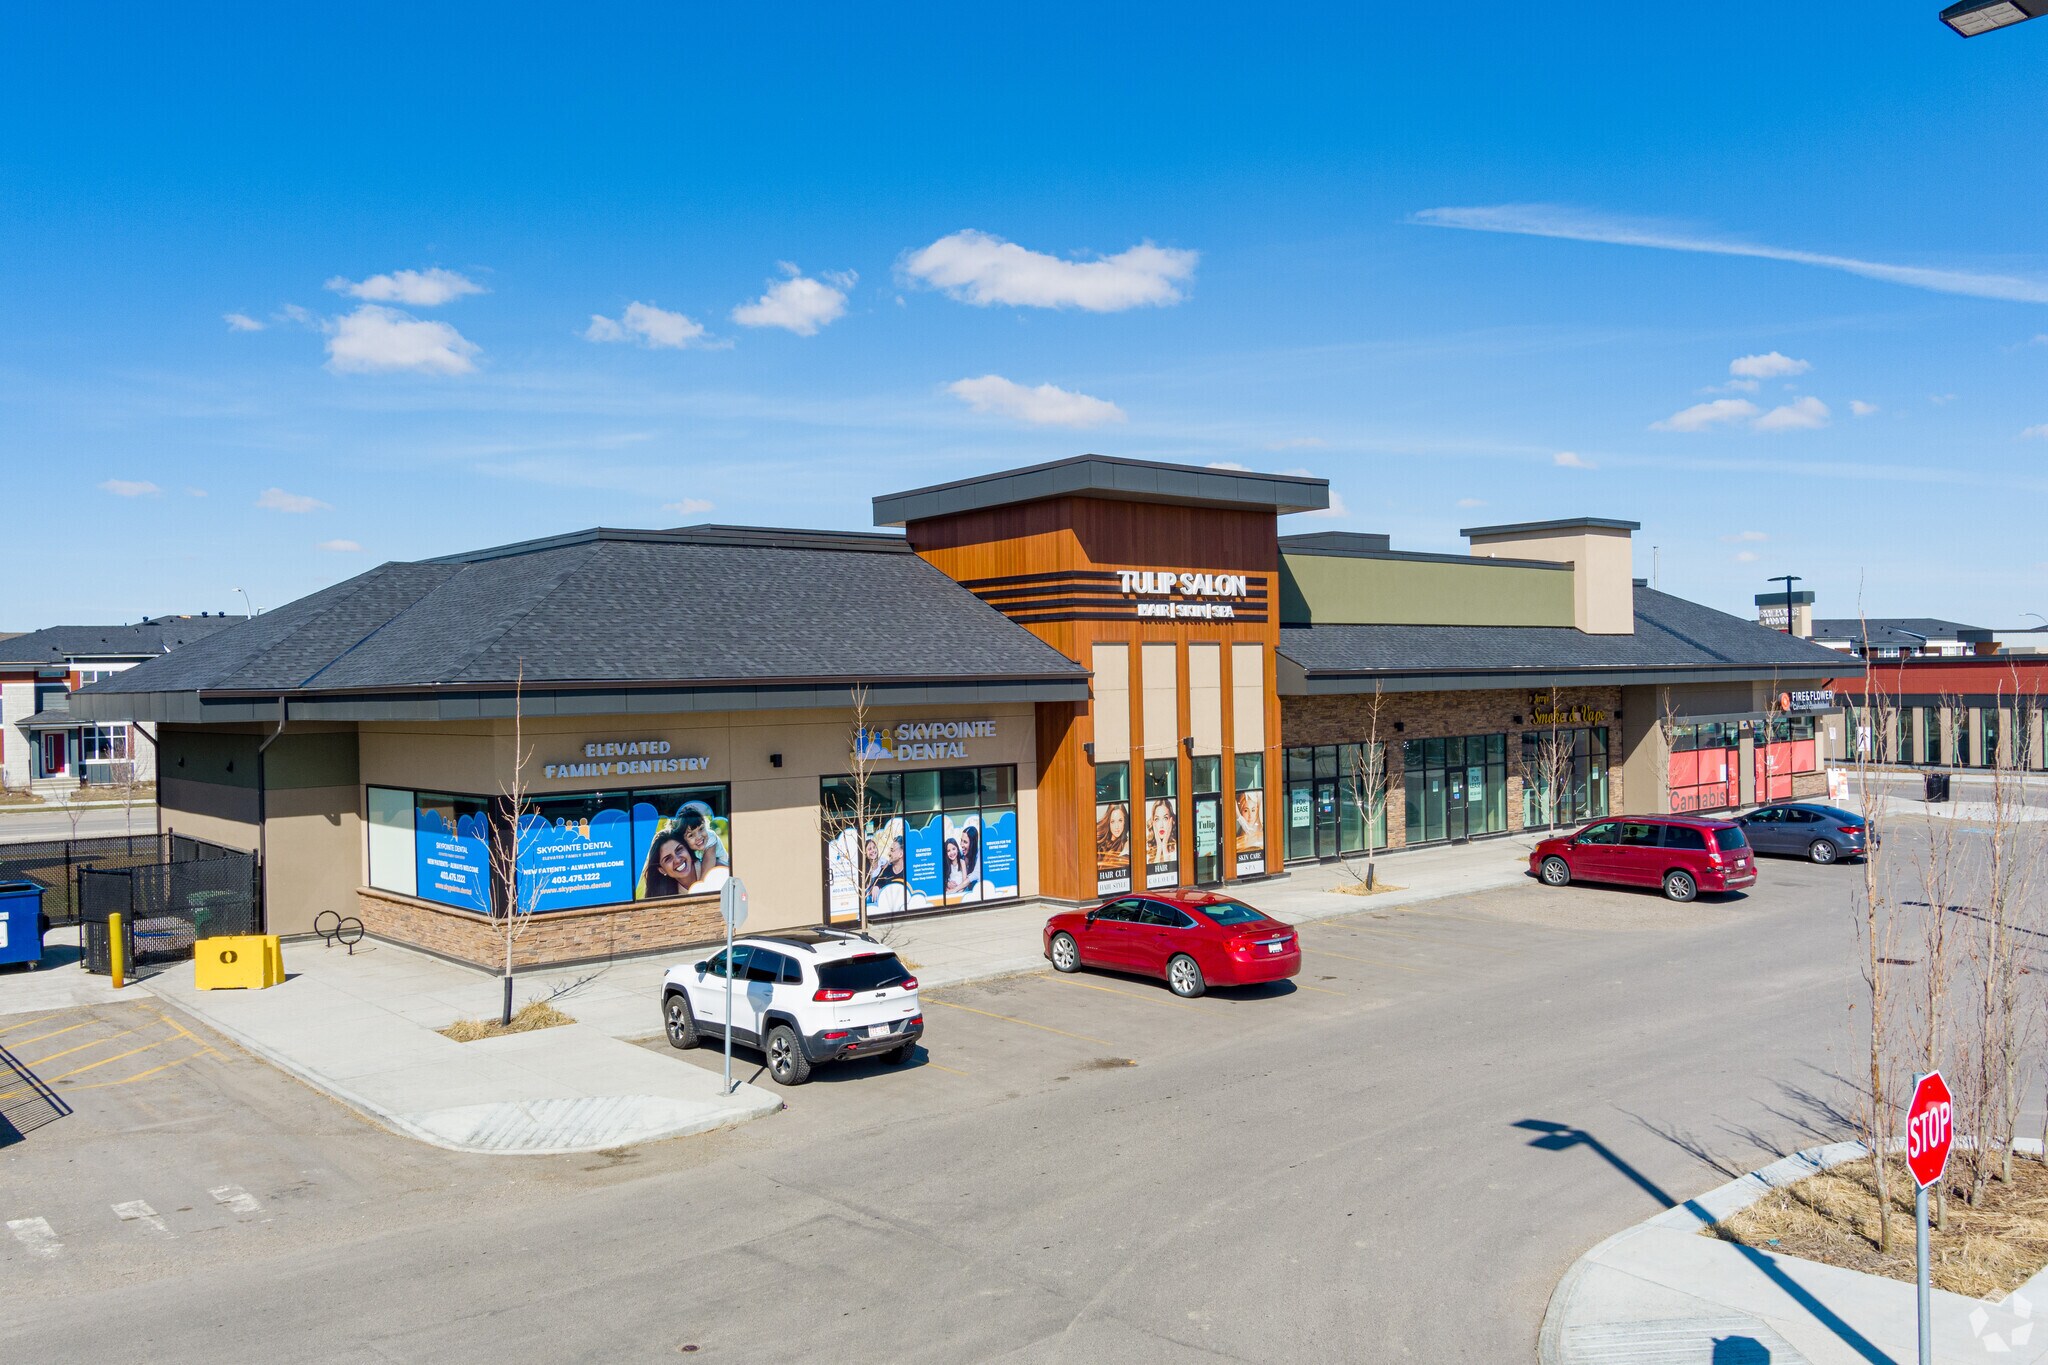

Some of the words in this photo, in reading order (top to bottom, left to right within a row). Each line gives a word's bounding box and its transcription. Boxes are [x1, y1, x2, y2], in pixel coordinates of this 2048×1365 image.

[1117, 570, 1177, 594] TULIP
[1180, 572, 1246, 597] SALON
[1137, 603, 1171, 617] HAIR
[1176, 604, 1207, 618] SKIN
[1211, 605, 1235, 618] SPA
[1532, 707, 1565, 725] Smoke
[1581, 704, 1606, 727] Vape
[897, 720, 997, 741] SKYPOINTE
[585, 741, 671, 758] ELEVATED
[897, 741, 969, 762] DENTAL
[545, 762, 612, 779] FAMILY
[616, 757, 710, 775] DENTISTRY
[1669, 786, 1726, 812] Cannabis
[1198, 820, 1216, 829] Tulip
[536, 844, 581, 855] SKYPOINTE
[583, 841, 613, 850] DENTAL
[538, 865, 566, 874] PATIENTS
[571, 862, 596, 870] ALWAYS
[596, 860, 624, 868] WELCOME
[1100, 871, 1114, 880] HAIR
[1115, 869, 1127, 877] CUT
[1155, 864, 1168, 873] HAIR
[552, 873, 600, 884] 403.475.1222
[540, 881, 612, 894] www.skypointe.dental
[1909, 1101, 1950, 1159] STOP
